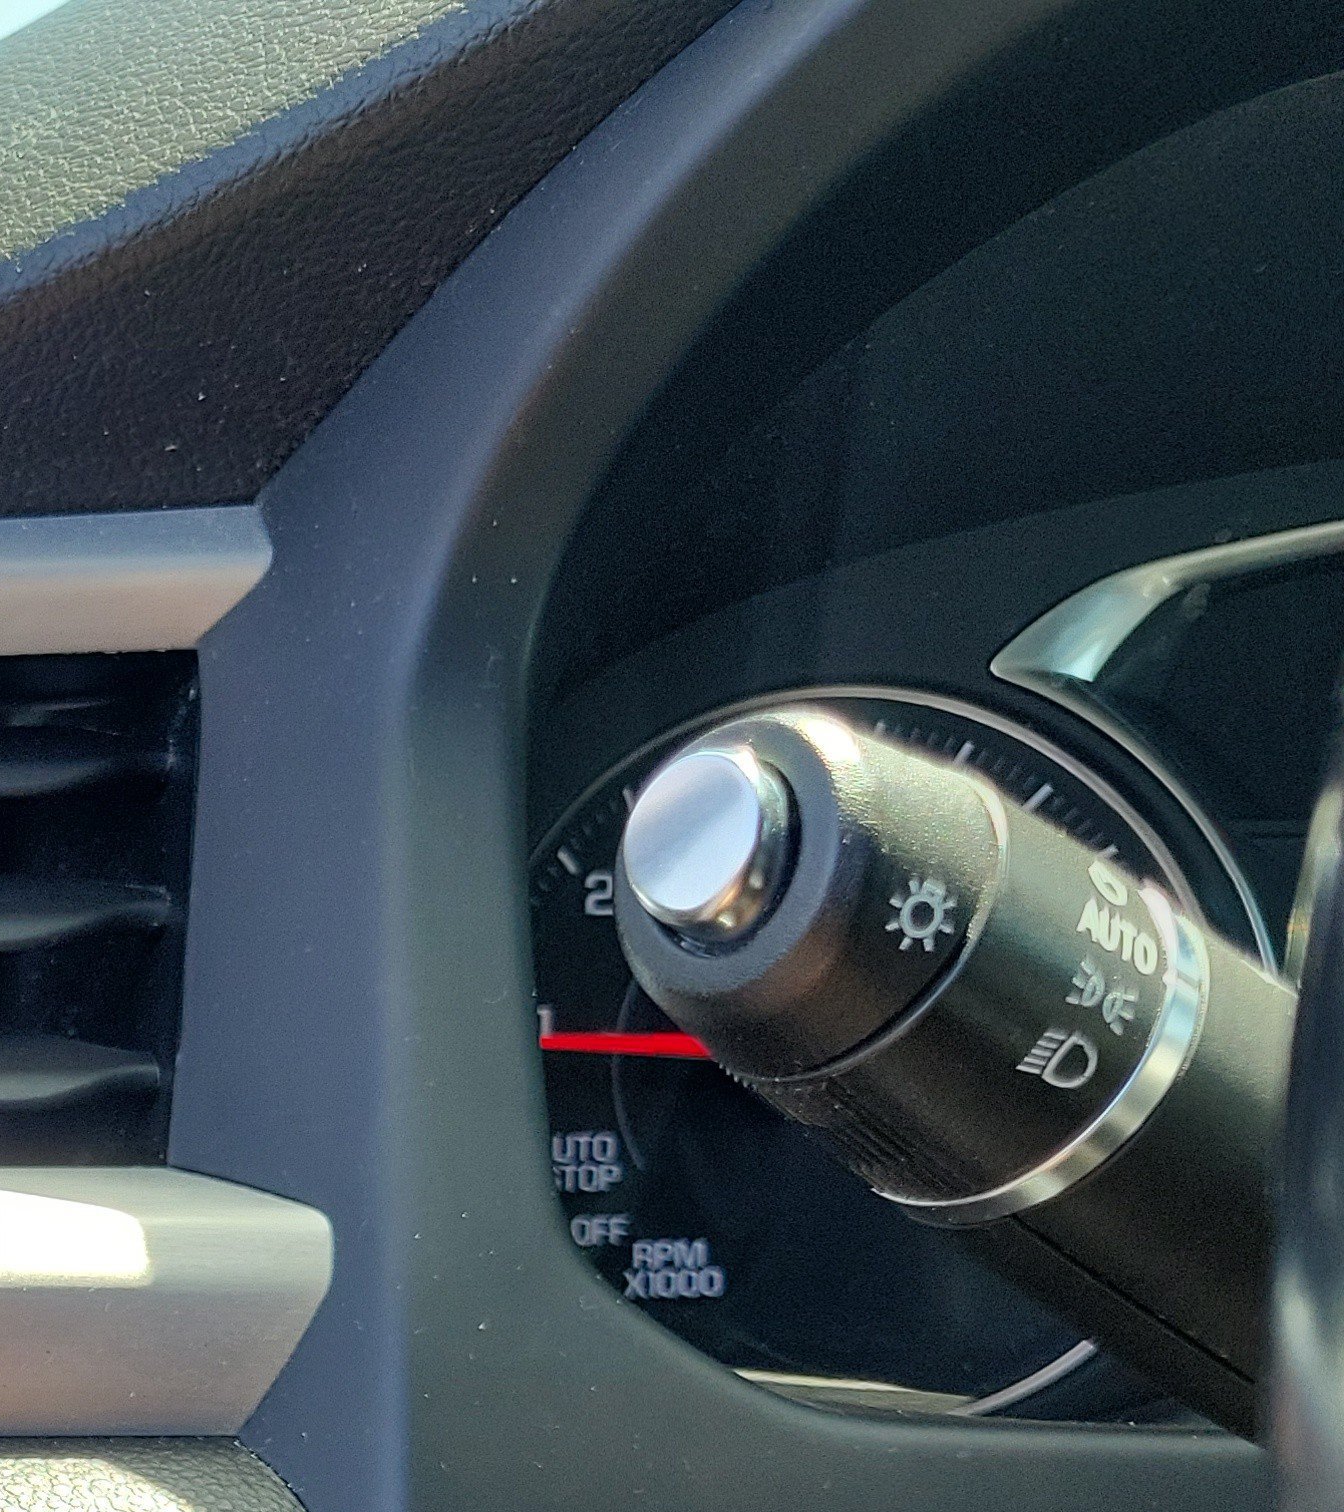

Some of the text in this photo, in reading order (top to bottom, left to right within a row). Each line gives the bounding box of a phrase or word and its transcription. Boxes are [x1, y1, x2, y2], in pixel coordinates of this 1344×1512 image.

[584, 870, 614, 917] 2
[1075, 896, 1159, 976] AUTO
[552, 1131, 617, 1163] UTO
[570, 1214, 631, 1246] OFF
[631, 1238, 710, 1270] RPM
[621, 1266, 726, 1299] X1000
